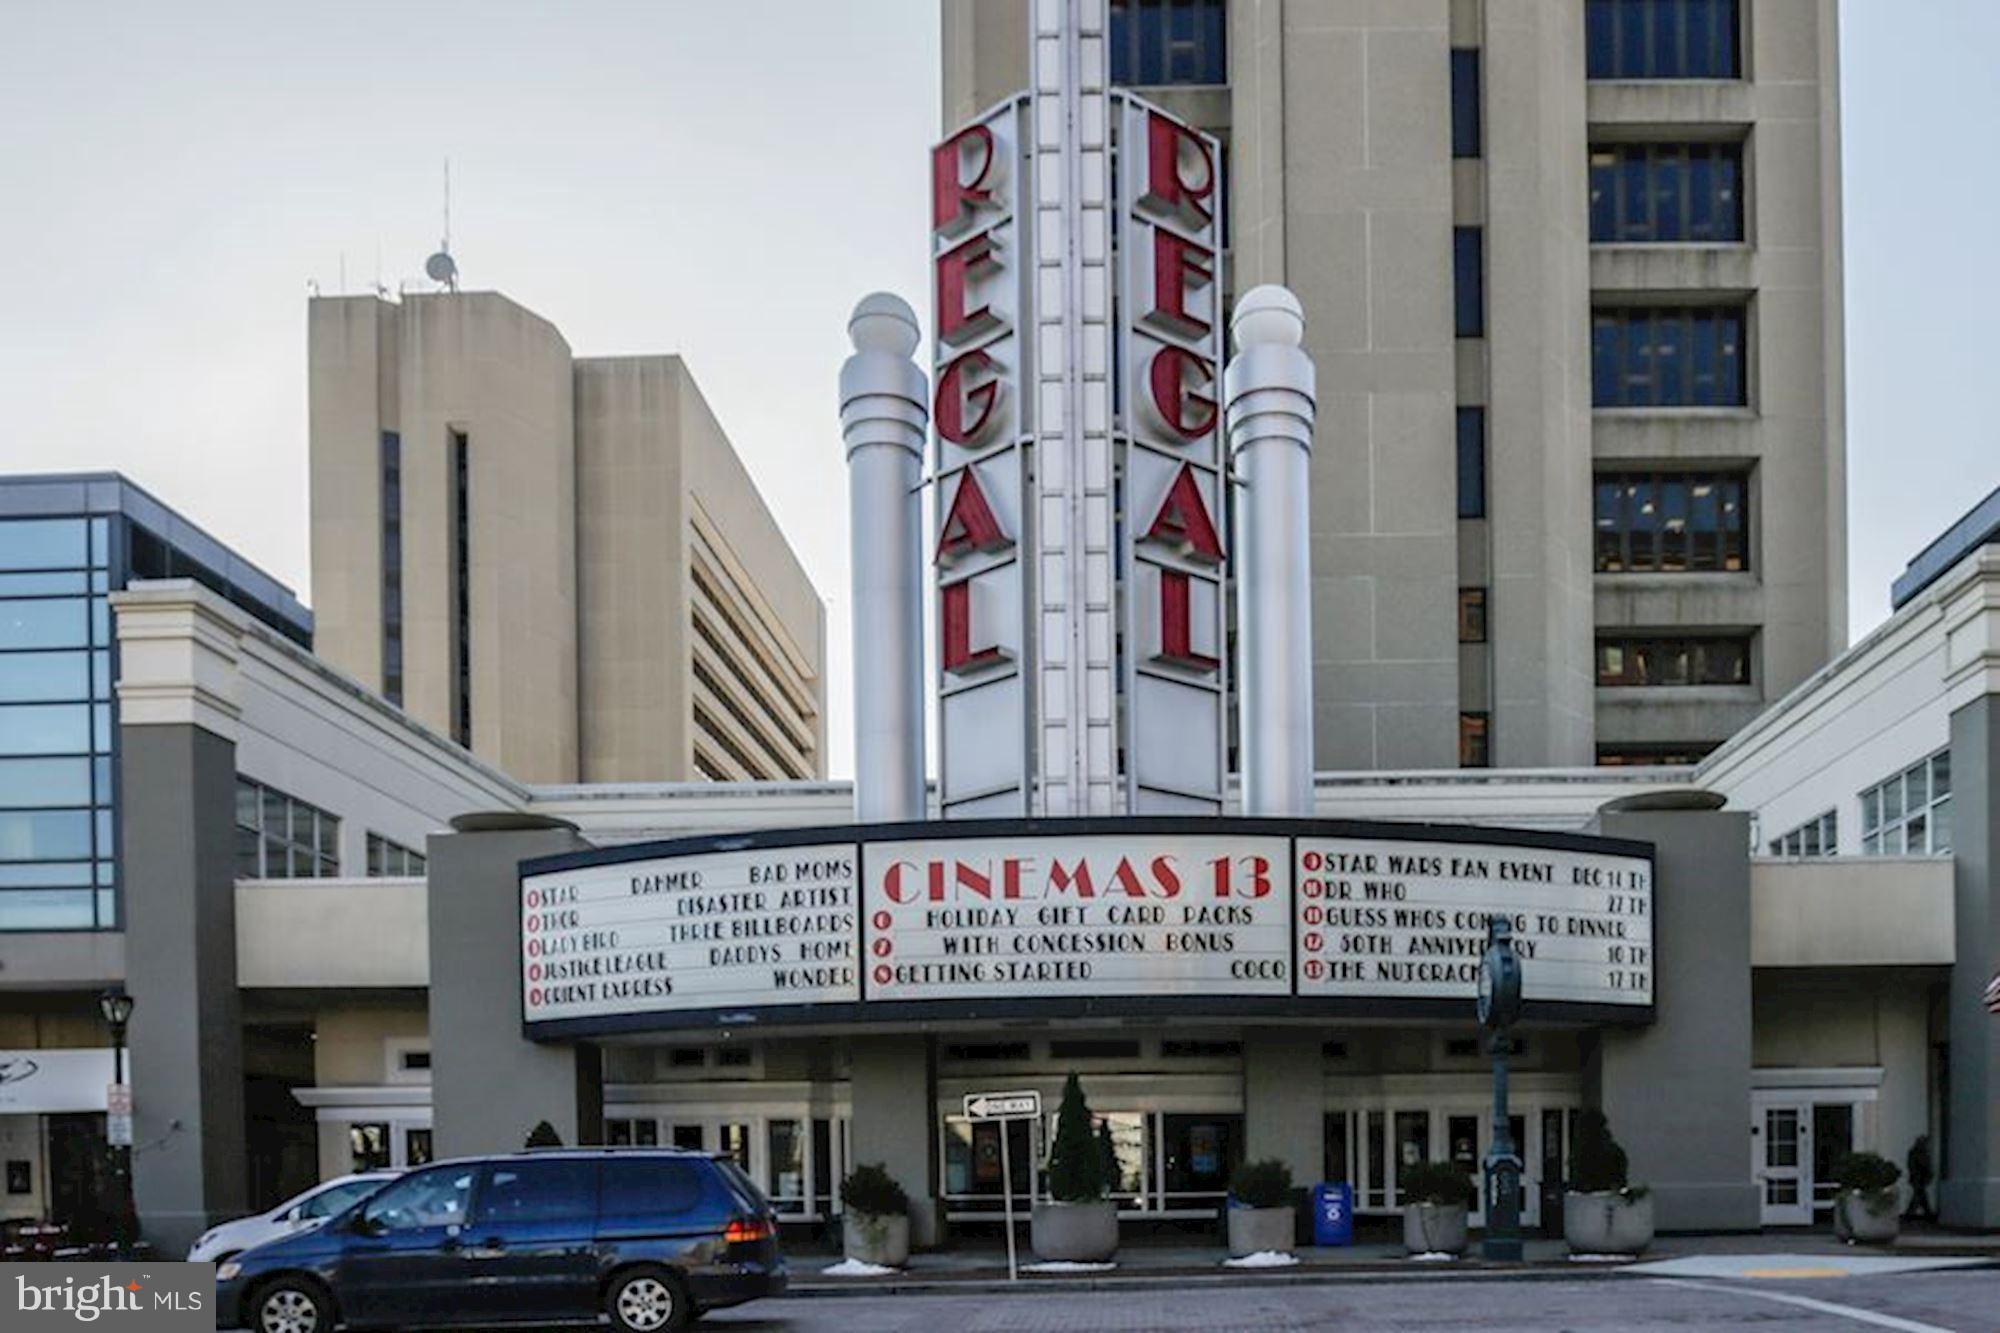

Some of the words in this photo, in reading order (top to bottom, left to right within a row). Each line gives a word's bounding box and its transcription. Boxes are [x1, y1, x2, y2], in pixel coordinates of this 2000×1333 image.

[932, 124, 1012, 672] REGAL
[1142, 108, 1225, 670] REGAL
[749, 864, 788, 884] BAD
[796, 860, 852, 880] MOMS
[884, 854, 1181, 904] CINEMAS
[1205, 855, 1271, 899] 13
[1325, 853, 1377, 873] STAR
[1389, 855, 1441, 877] WARS
[1451, 857, 1489, 879] FAN
[1500, 861, 1553, 882] EVENT
[1573, 867, 1602, 886] DEC
[631, 871, 702, 895] DAHMER
[1325, 881, 1351, 900] DR
[1364, 882, 1406, 901] WHO
[542, 886, 578, 906] STAR
[677, 891, 766, 916] DISASTER
[780, 887, 851, 909] ARTIST
[543, 909, 579, 931] THOR
[670, 920, 726, 943] THREE
[732, 914, 853, 938] BILLBOARDS
[927, 908, 1016, 928] HOLIDAY
[1038, 906, 1087, 927] GIFT
[1108, 906, 1165, 925] CARD
[1184, 905, 1253, 925] PACKS
[1326, 906, 1387, 927] GUESS
[1395, 909, 1446, 929] WHOS
[1455, 912, 1527, 933] COMG
[1537, 915, 1559, 934] TO
[1568, 918, 1625, 938] DINNER
[542, 936, 577, 955] LADY
[583, 932, 619, 951] BIRD
[710, 944, 781, 966] DADDYS
[800, 941, 852, 960] HOME
[944, 935, 998, 955] WITH
[1013, 932, 1145, 954] CONCESSION
[1167, 932, 1234, 951] BONUS
[1340, 935, 1392, 955] 50TH
[544, 957, 602, 980] JUSTICE
[606, 952, 667, 974] LEAGUE
[774, 967, 854, 989] WONDER
[896, 963, 985, 984] GETTING
[994, 961, 1091, 982] STARTED
[1231, 960, 1286, 980] COCO
[1328, 962, 1365, 980] THE
[544, 983, 597, 1005] ORIENT
[603, 977, 672, 1000] EXPRESS
